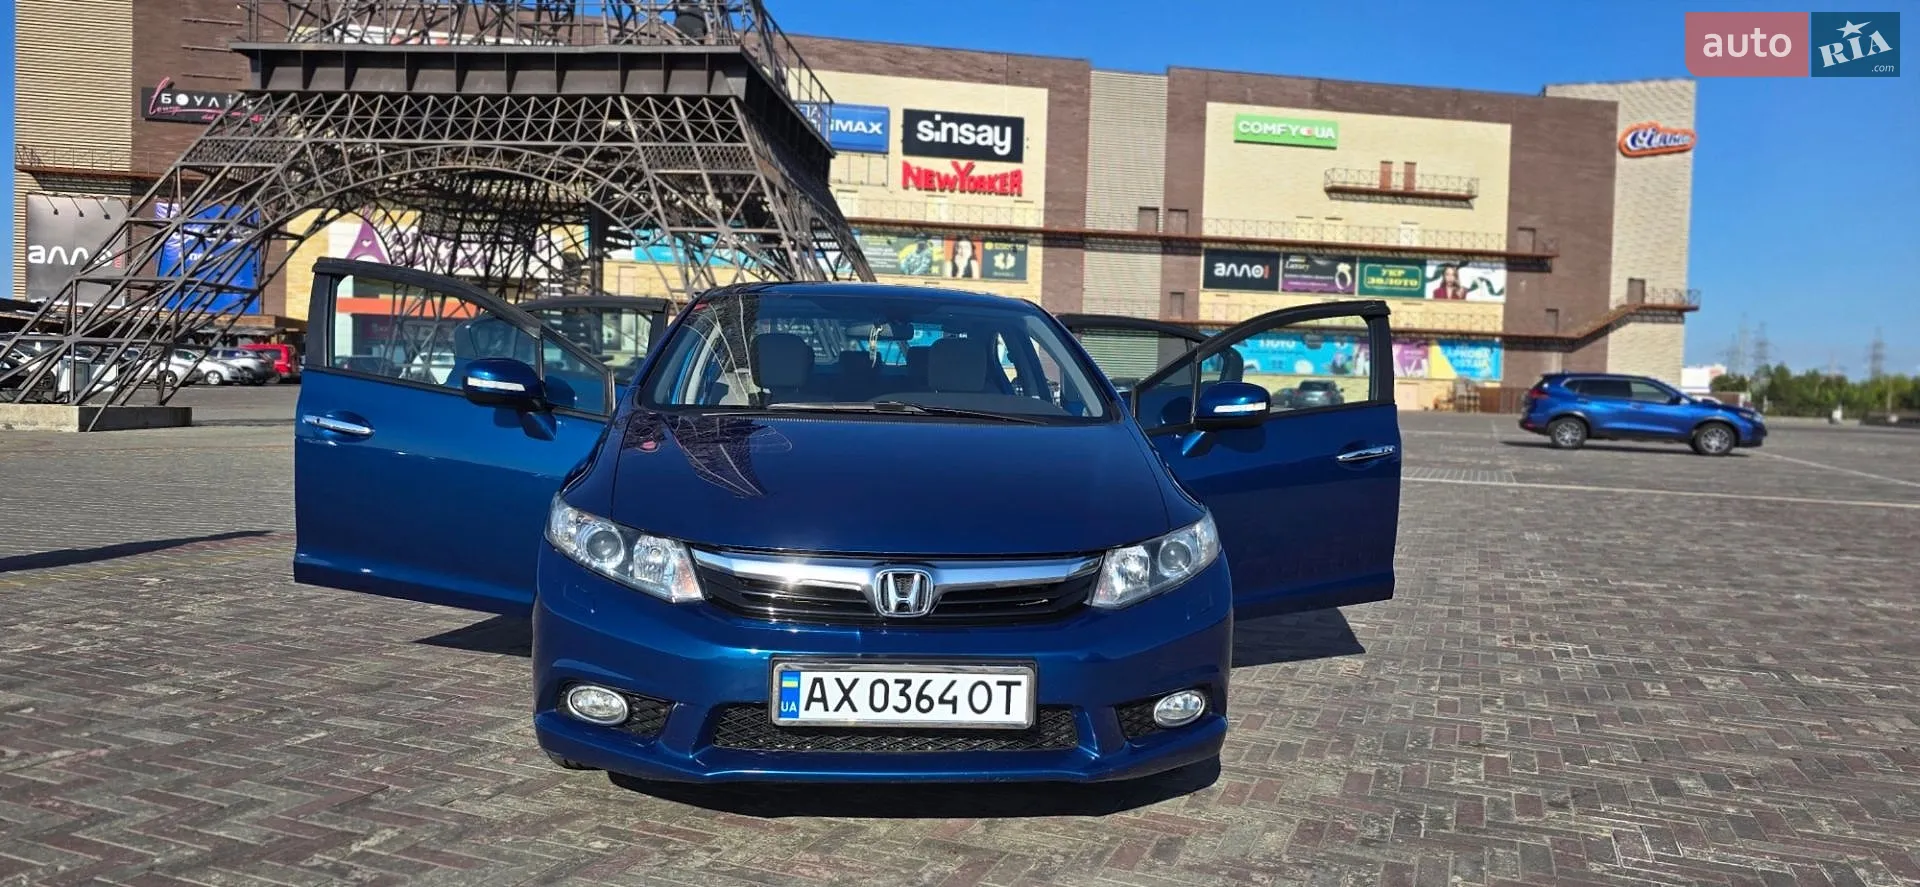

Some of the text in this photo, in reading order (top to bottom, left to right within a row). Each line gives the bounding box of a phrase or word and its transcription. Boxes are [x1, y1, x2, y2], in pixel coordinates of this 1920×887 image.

[830, 118, 883, 135] IMAX
[916, 113, 1012, 156] sinsay
[1239, 120, 1300, 136] COMFY
[804, 677, 1022, 715] AX 0364 OT
[780, 701, 797, 713] UA
